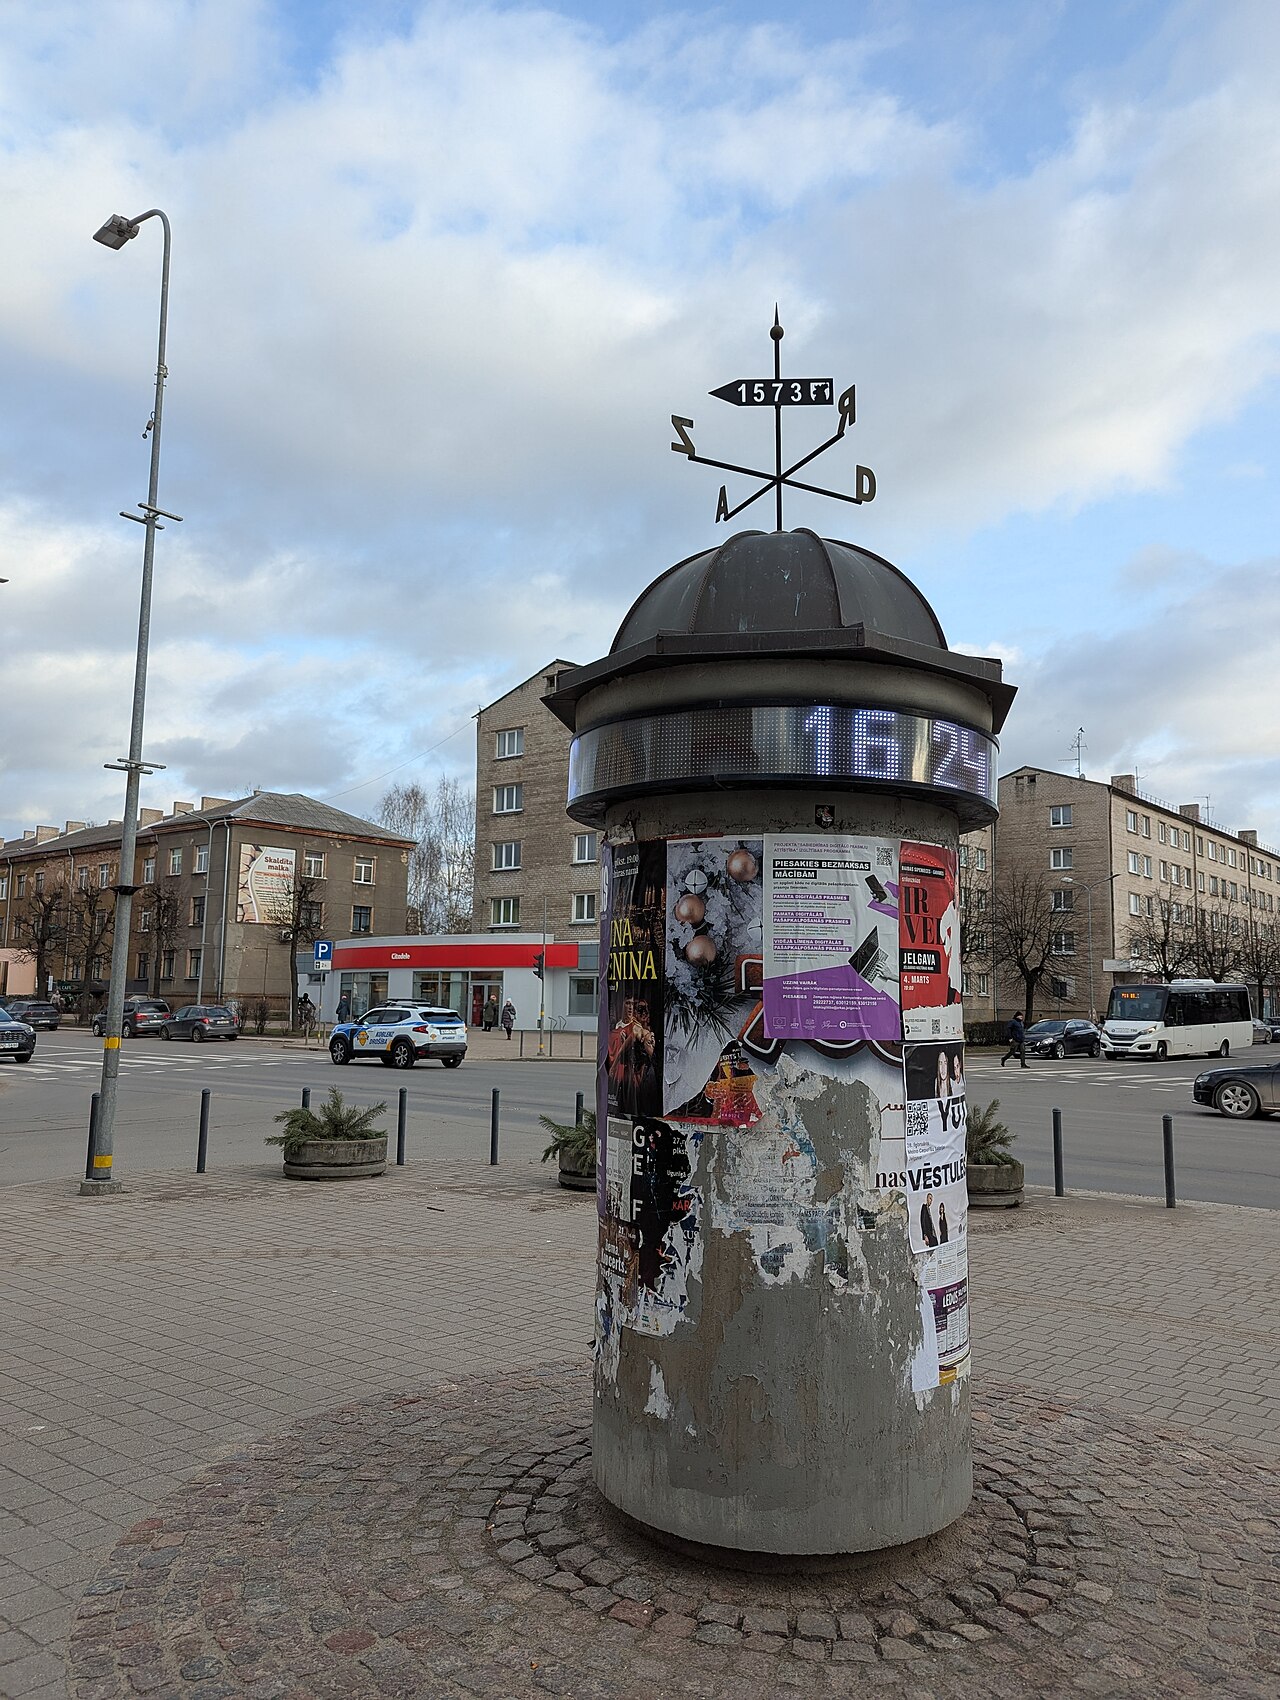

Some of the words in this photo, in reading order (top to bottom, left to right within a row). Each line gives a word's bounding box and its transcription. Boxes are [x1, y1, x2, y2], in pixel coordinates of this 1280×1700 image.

[737, 382, 802, 404] 1573
[855, 464, 877, 503] D
[715, 485, 729, 524] A
[805, 707, 900, 780] 16
[932, 720, 986, 796] 24
[775, 860, 820, 868] PIESAKIES
[821, 861, 870, 870] BEZMAKSAS
[318, 943, 329, 958] P
[902, 952, 936, 966] JELGAVA
[903, 975, 910, 983] 4.
[911, 975, 930, 984] MARTS
